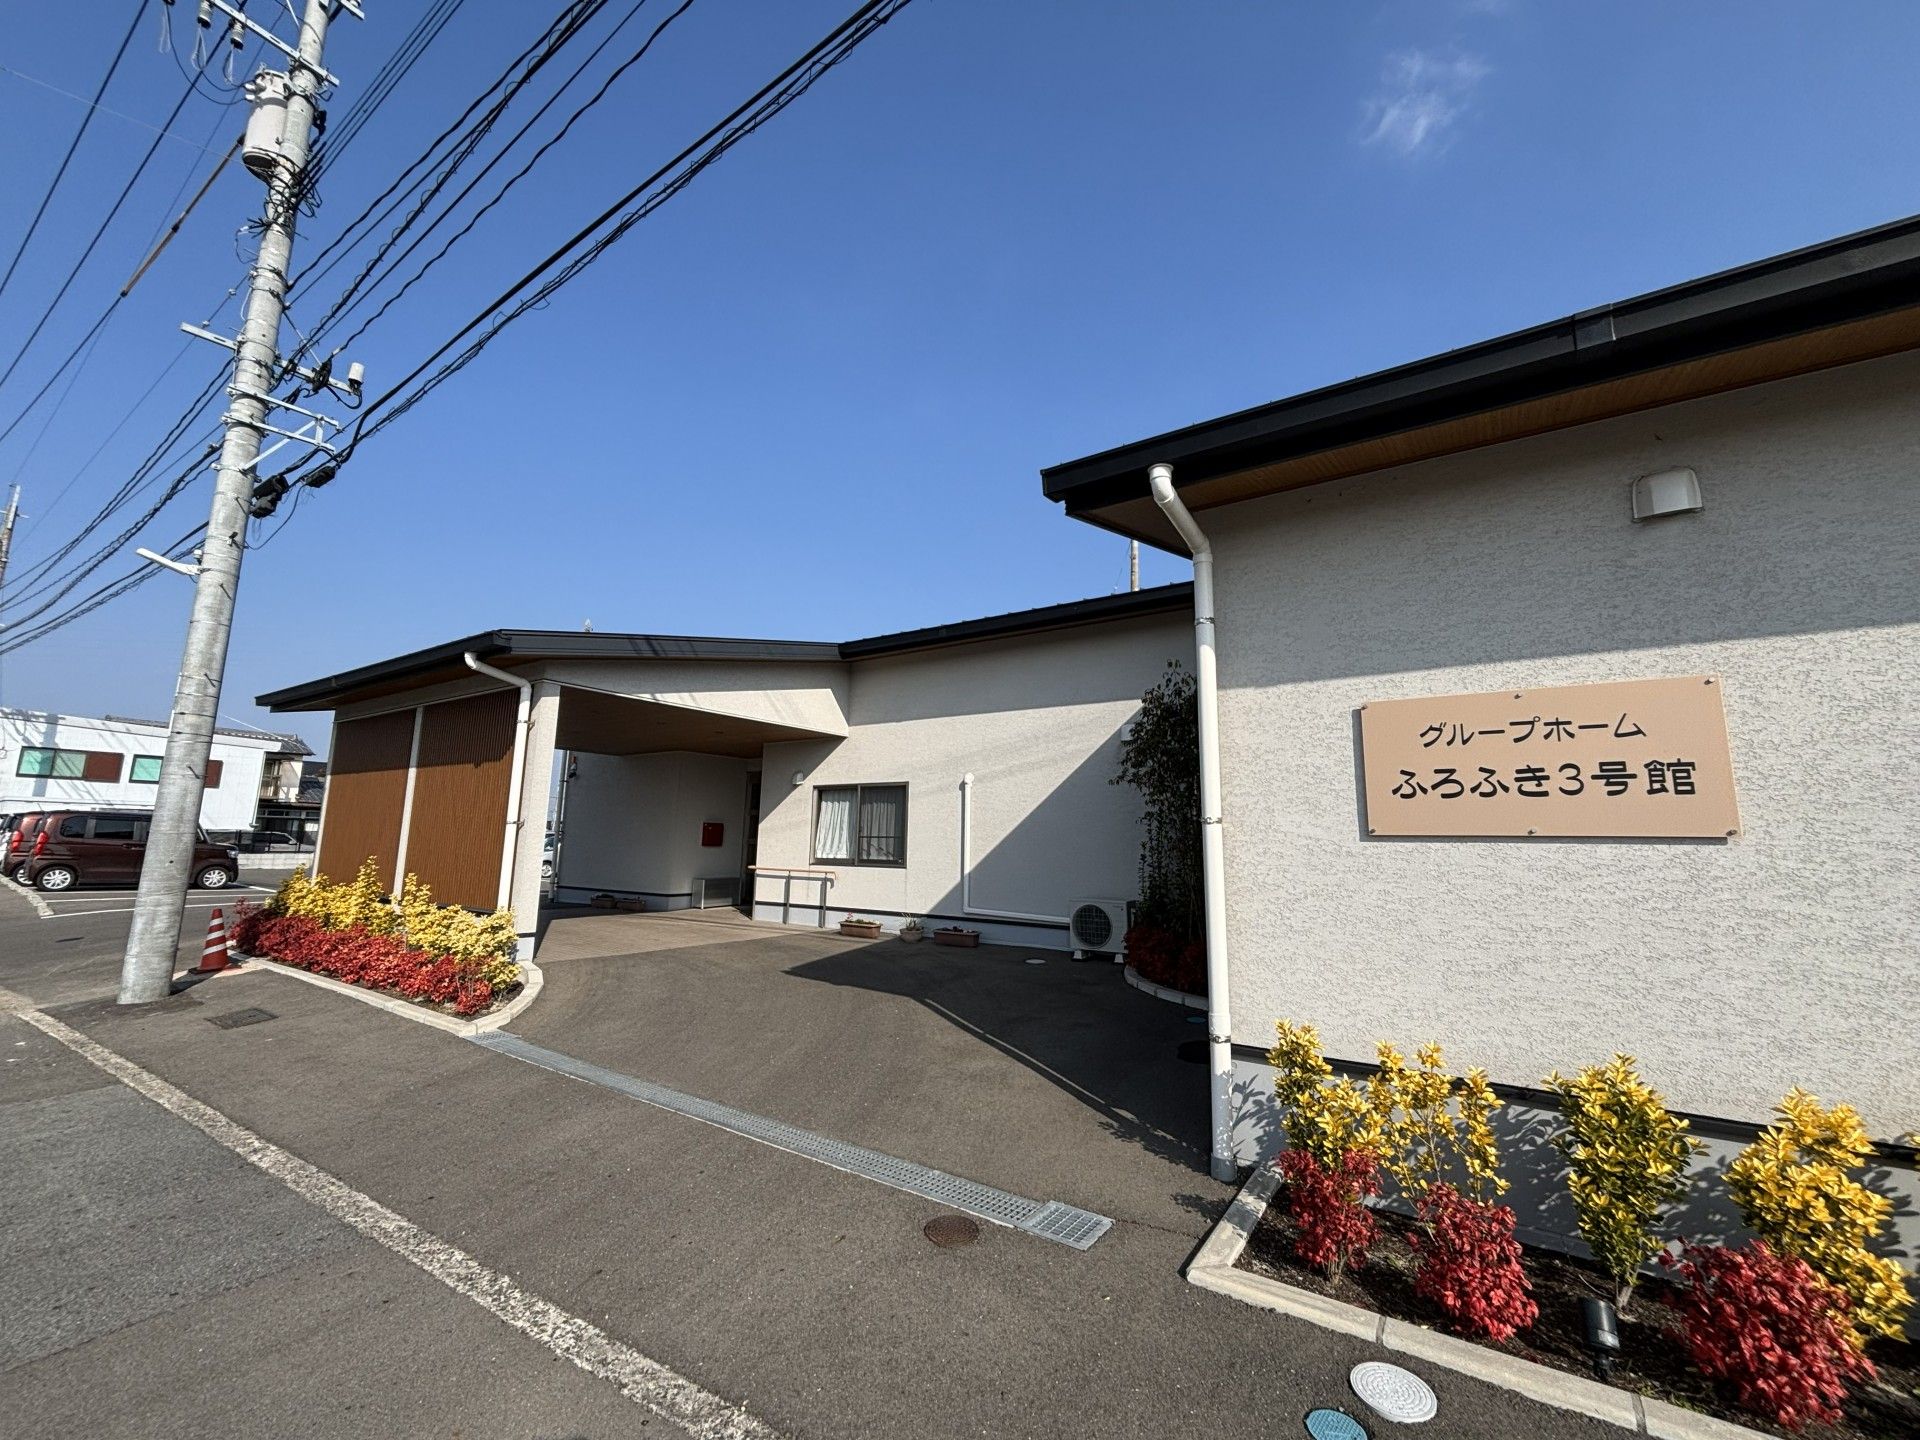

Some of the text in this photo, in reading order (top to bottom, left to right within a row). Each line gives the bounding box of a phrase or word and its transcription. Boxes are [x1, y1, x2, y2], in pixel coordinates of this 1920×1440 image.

[1419, 713, 1647, 748] グループホーム
[1391, 758, 1696, 800] ふろふき3号館
